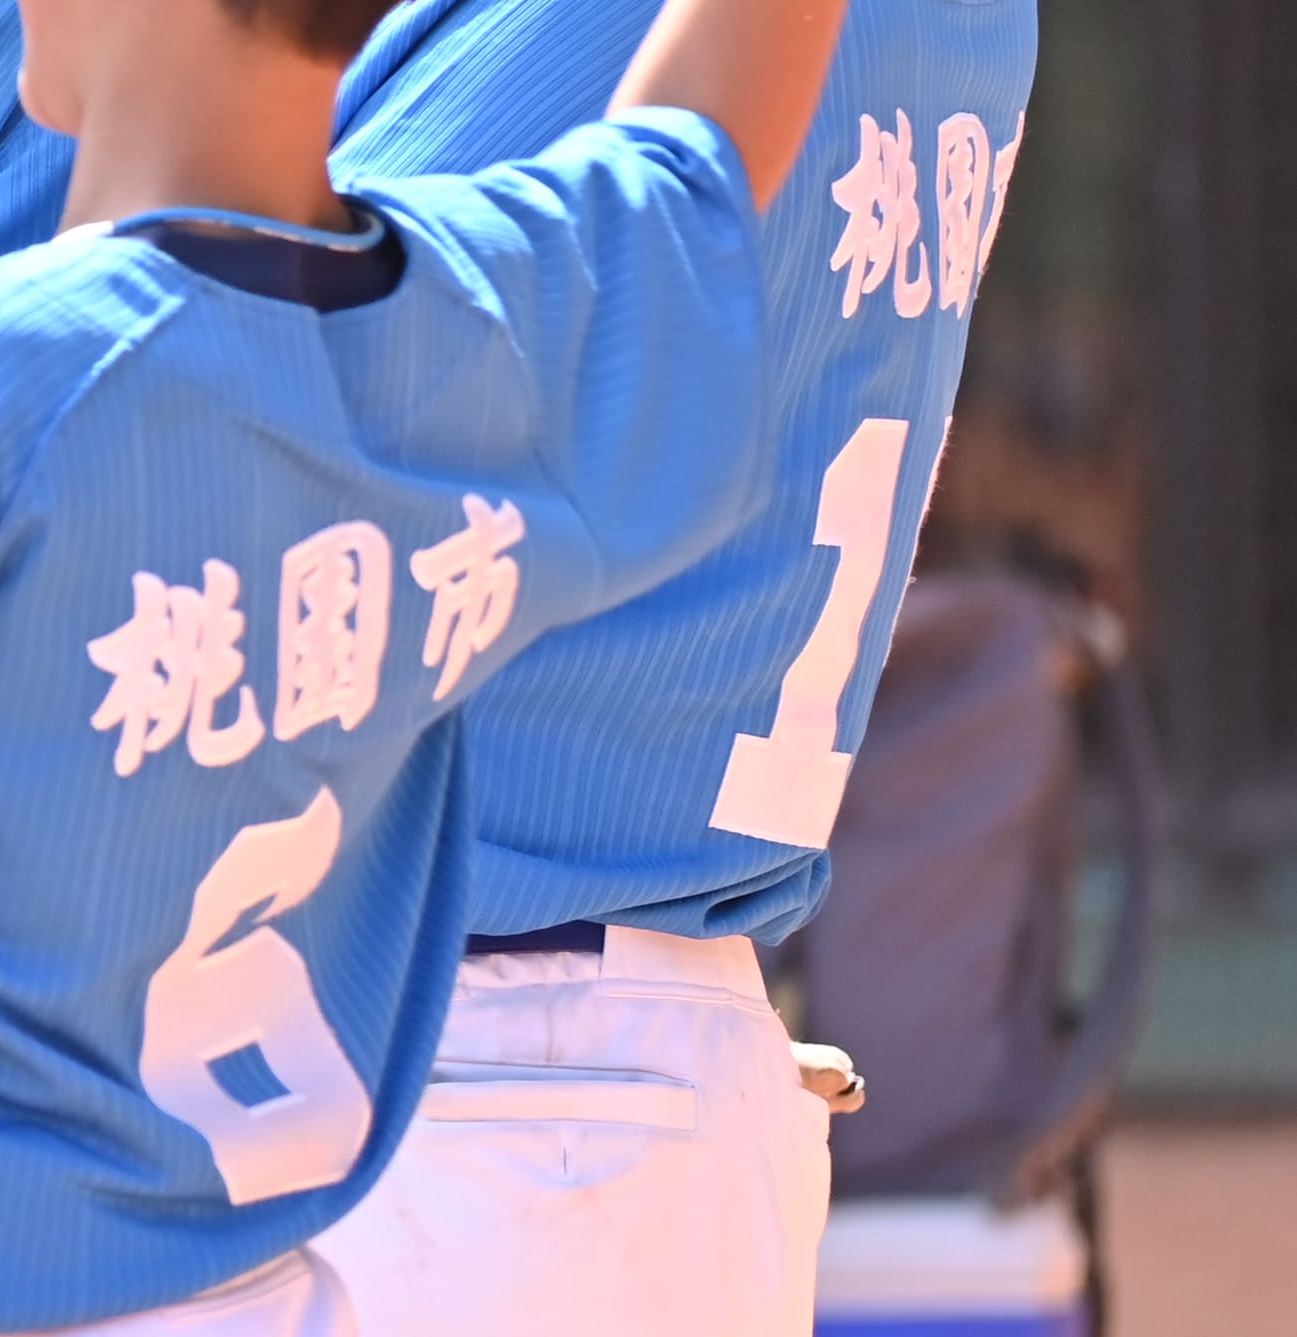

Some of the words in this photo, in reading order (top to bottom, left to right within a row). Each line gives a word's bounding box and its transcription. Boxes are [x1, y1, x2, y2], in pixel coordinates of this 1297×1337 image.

[88, 493, 526, 778] 桃園市
[709, 416, 952, 849] 1
[139, 785, 374, 1207] 6
